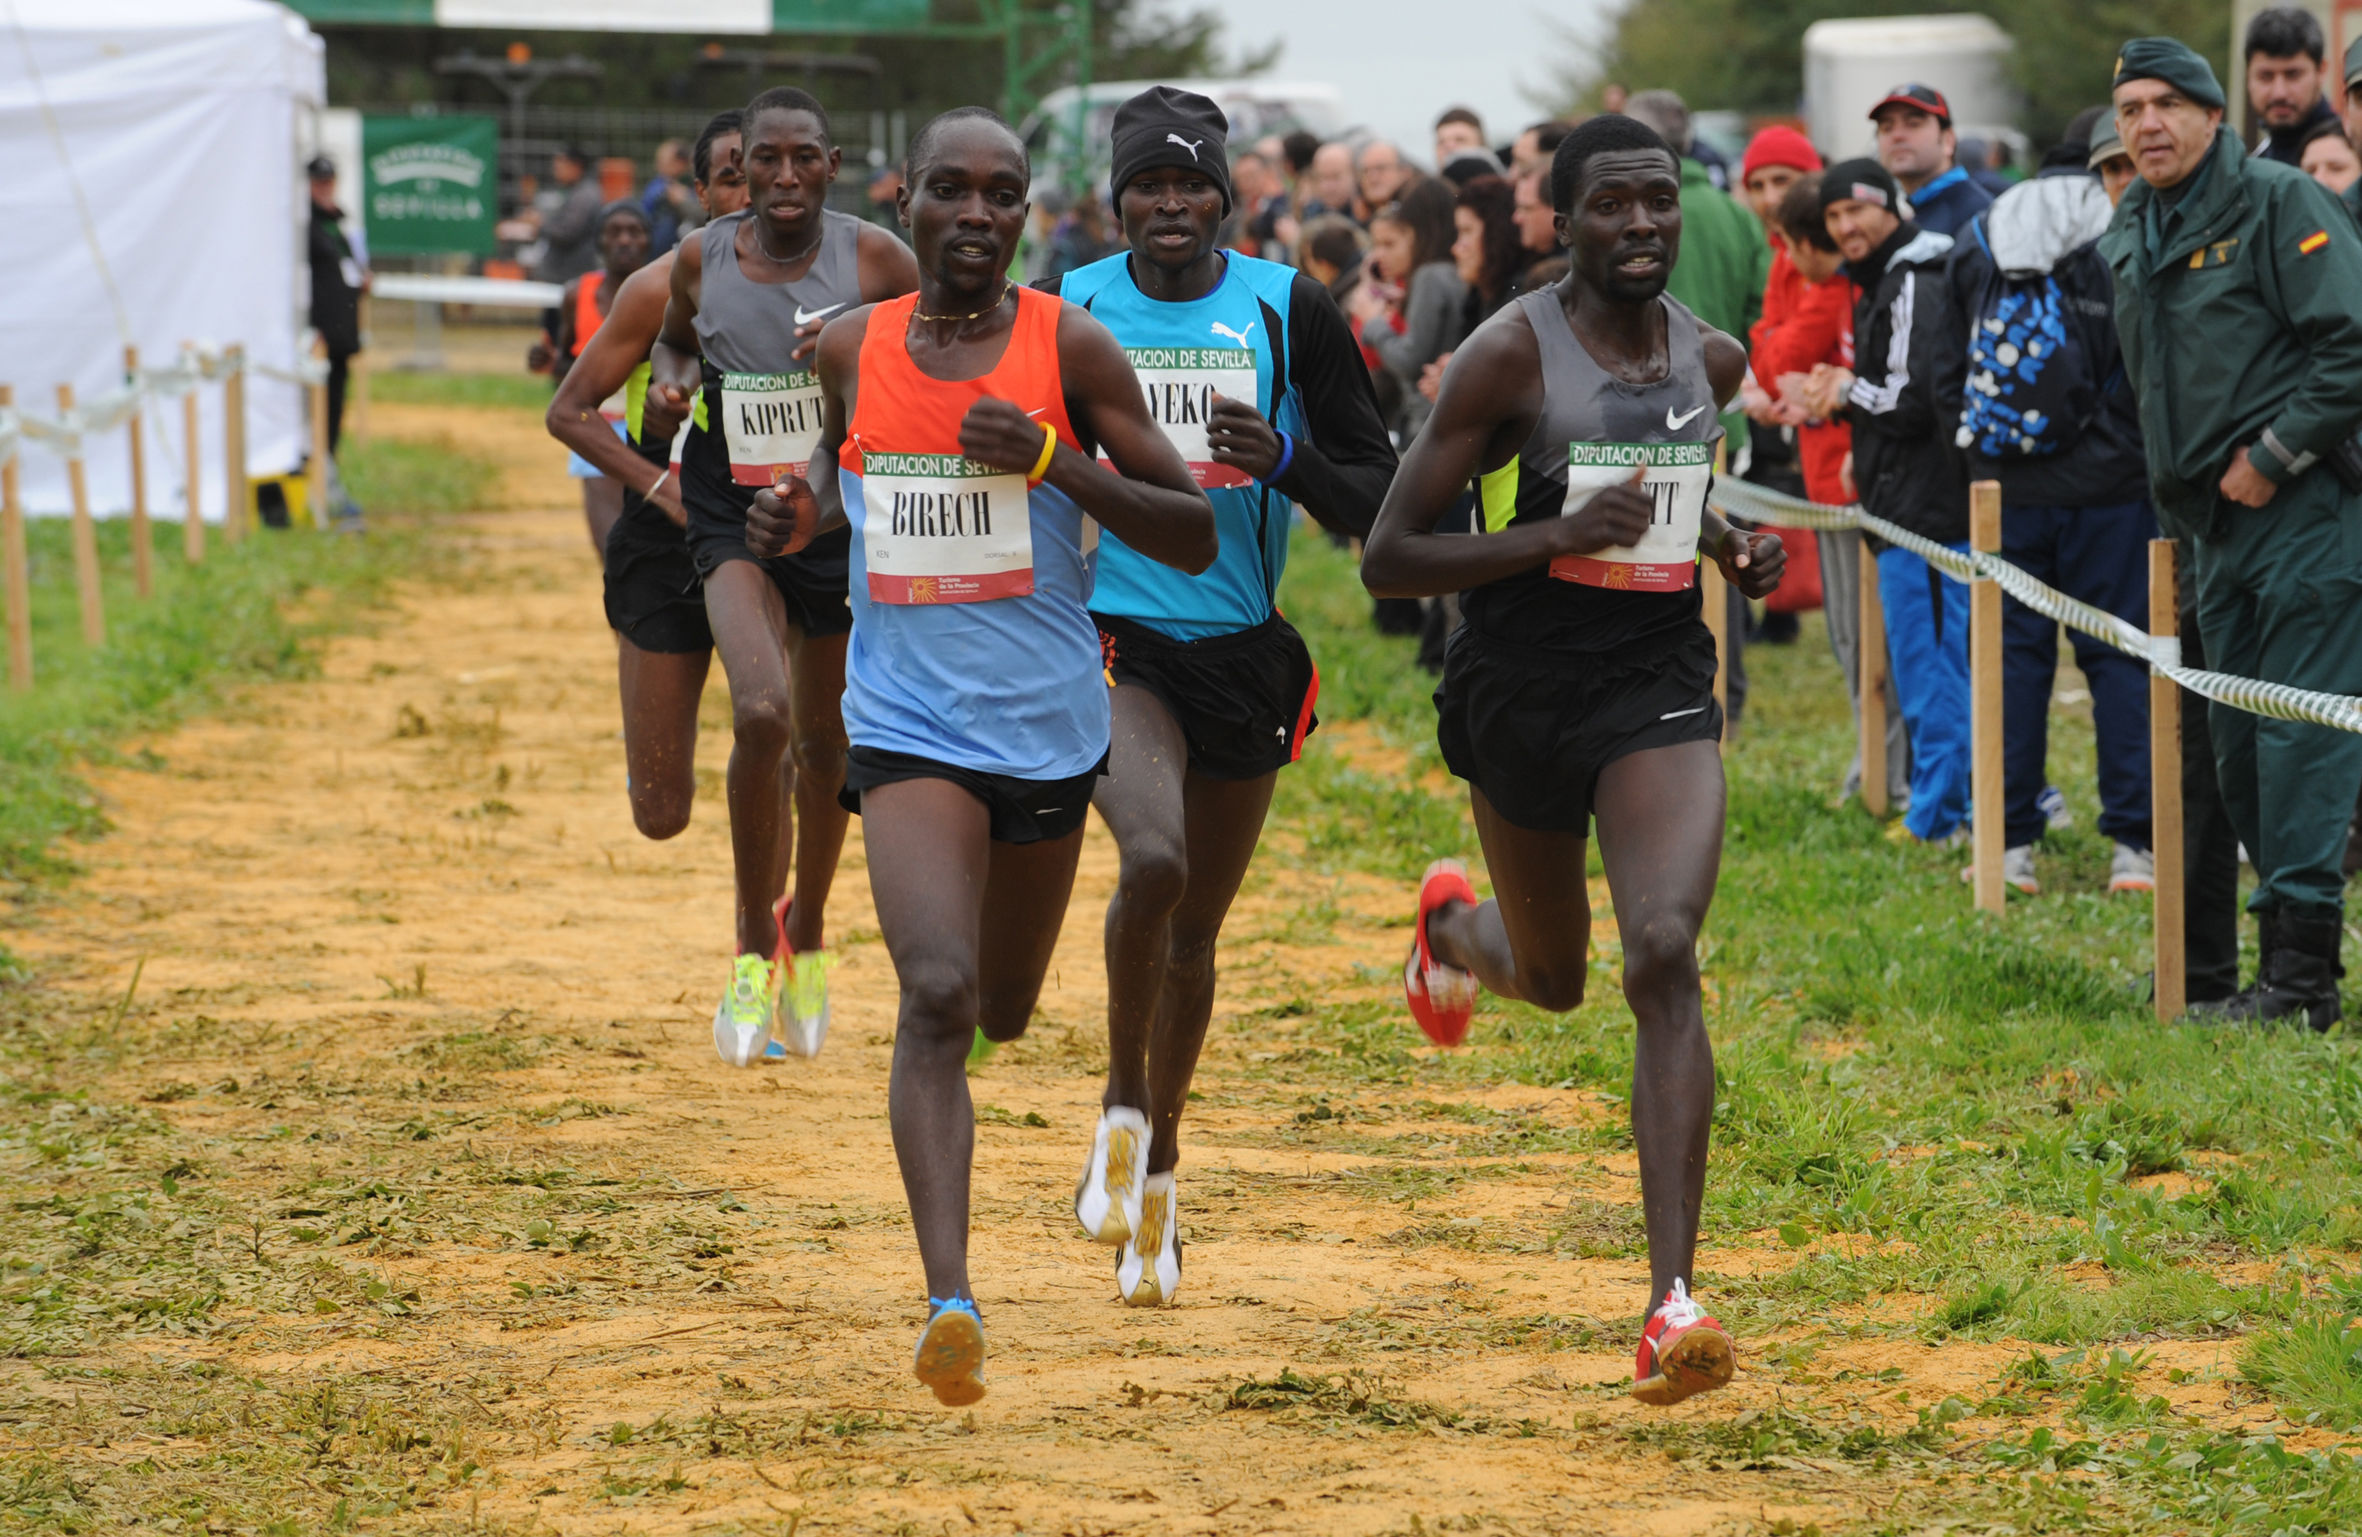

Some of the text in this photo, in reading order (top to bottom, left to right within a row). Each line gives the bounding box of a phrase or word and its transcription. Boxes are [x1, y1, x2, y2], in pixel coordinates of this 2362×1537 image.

[1179, 350, 1197, 368] DE
[1200, 350, 1251, 368] SEVILLA
[724, 374, 787, 391] DIPUTACION
[789, 372, 805, 388] DE
[1574, 445, 1656, 464] DIPUTACION
[1657, 446, 1673, 464] DE
[866, 455, 940, 475] DIPUTACION
[942, 457, 961, 476] DE
[892, 491, 992, 536] BIRECH
